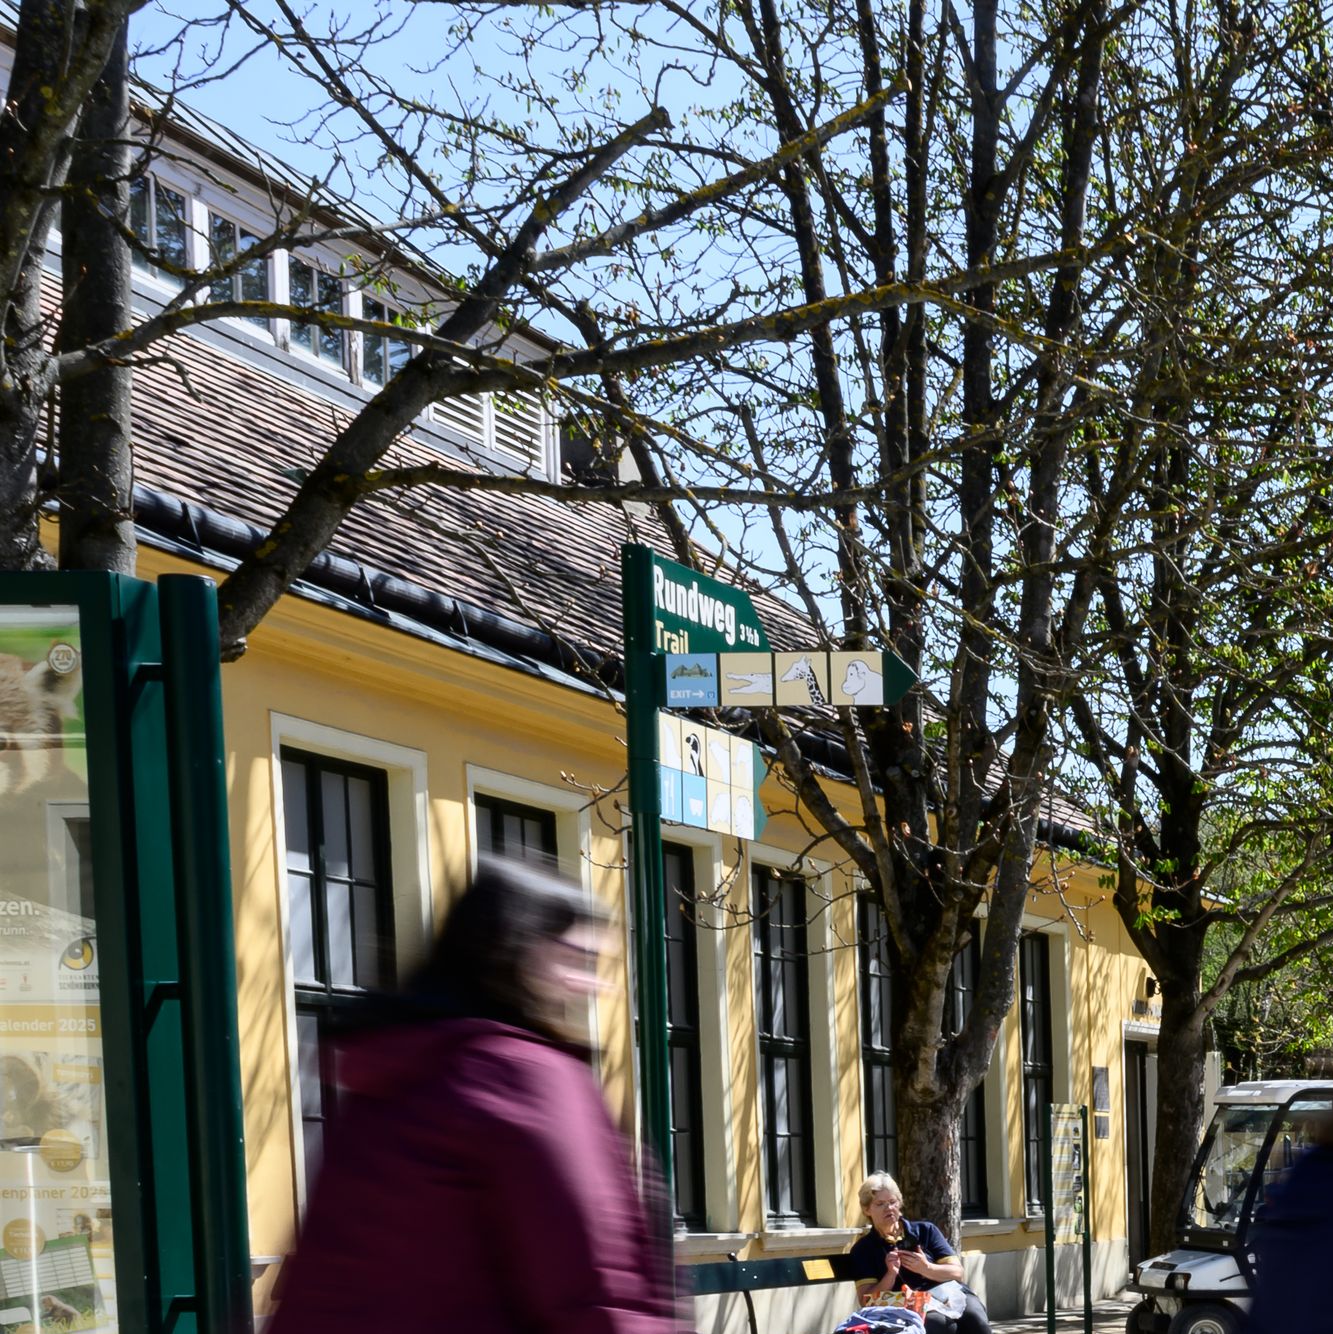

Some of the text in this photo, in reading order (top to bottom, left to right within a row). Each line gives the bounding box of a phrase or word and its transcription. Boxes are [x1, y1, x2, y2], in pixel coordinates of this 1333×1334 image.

[654, 565, 736, 646] Rundweg
[655, 620, 689, 654] Trail
[670, 689, 692, 699] EXIT
[58, 1018, 97, 1033] 2025
